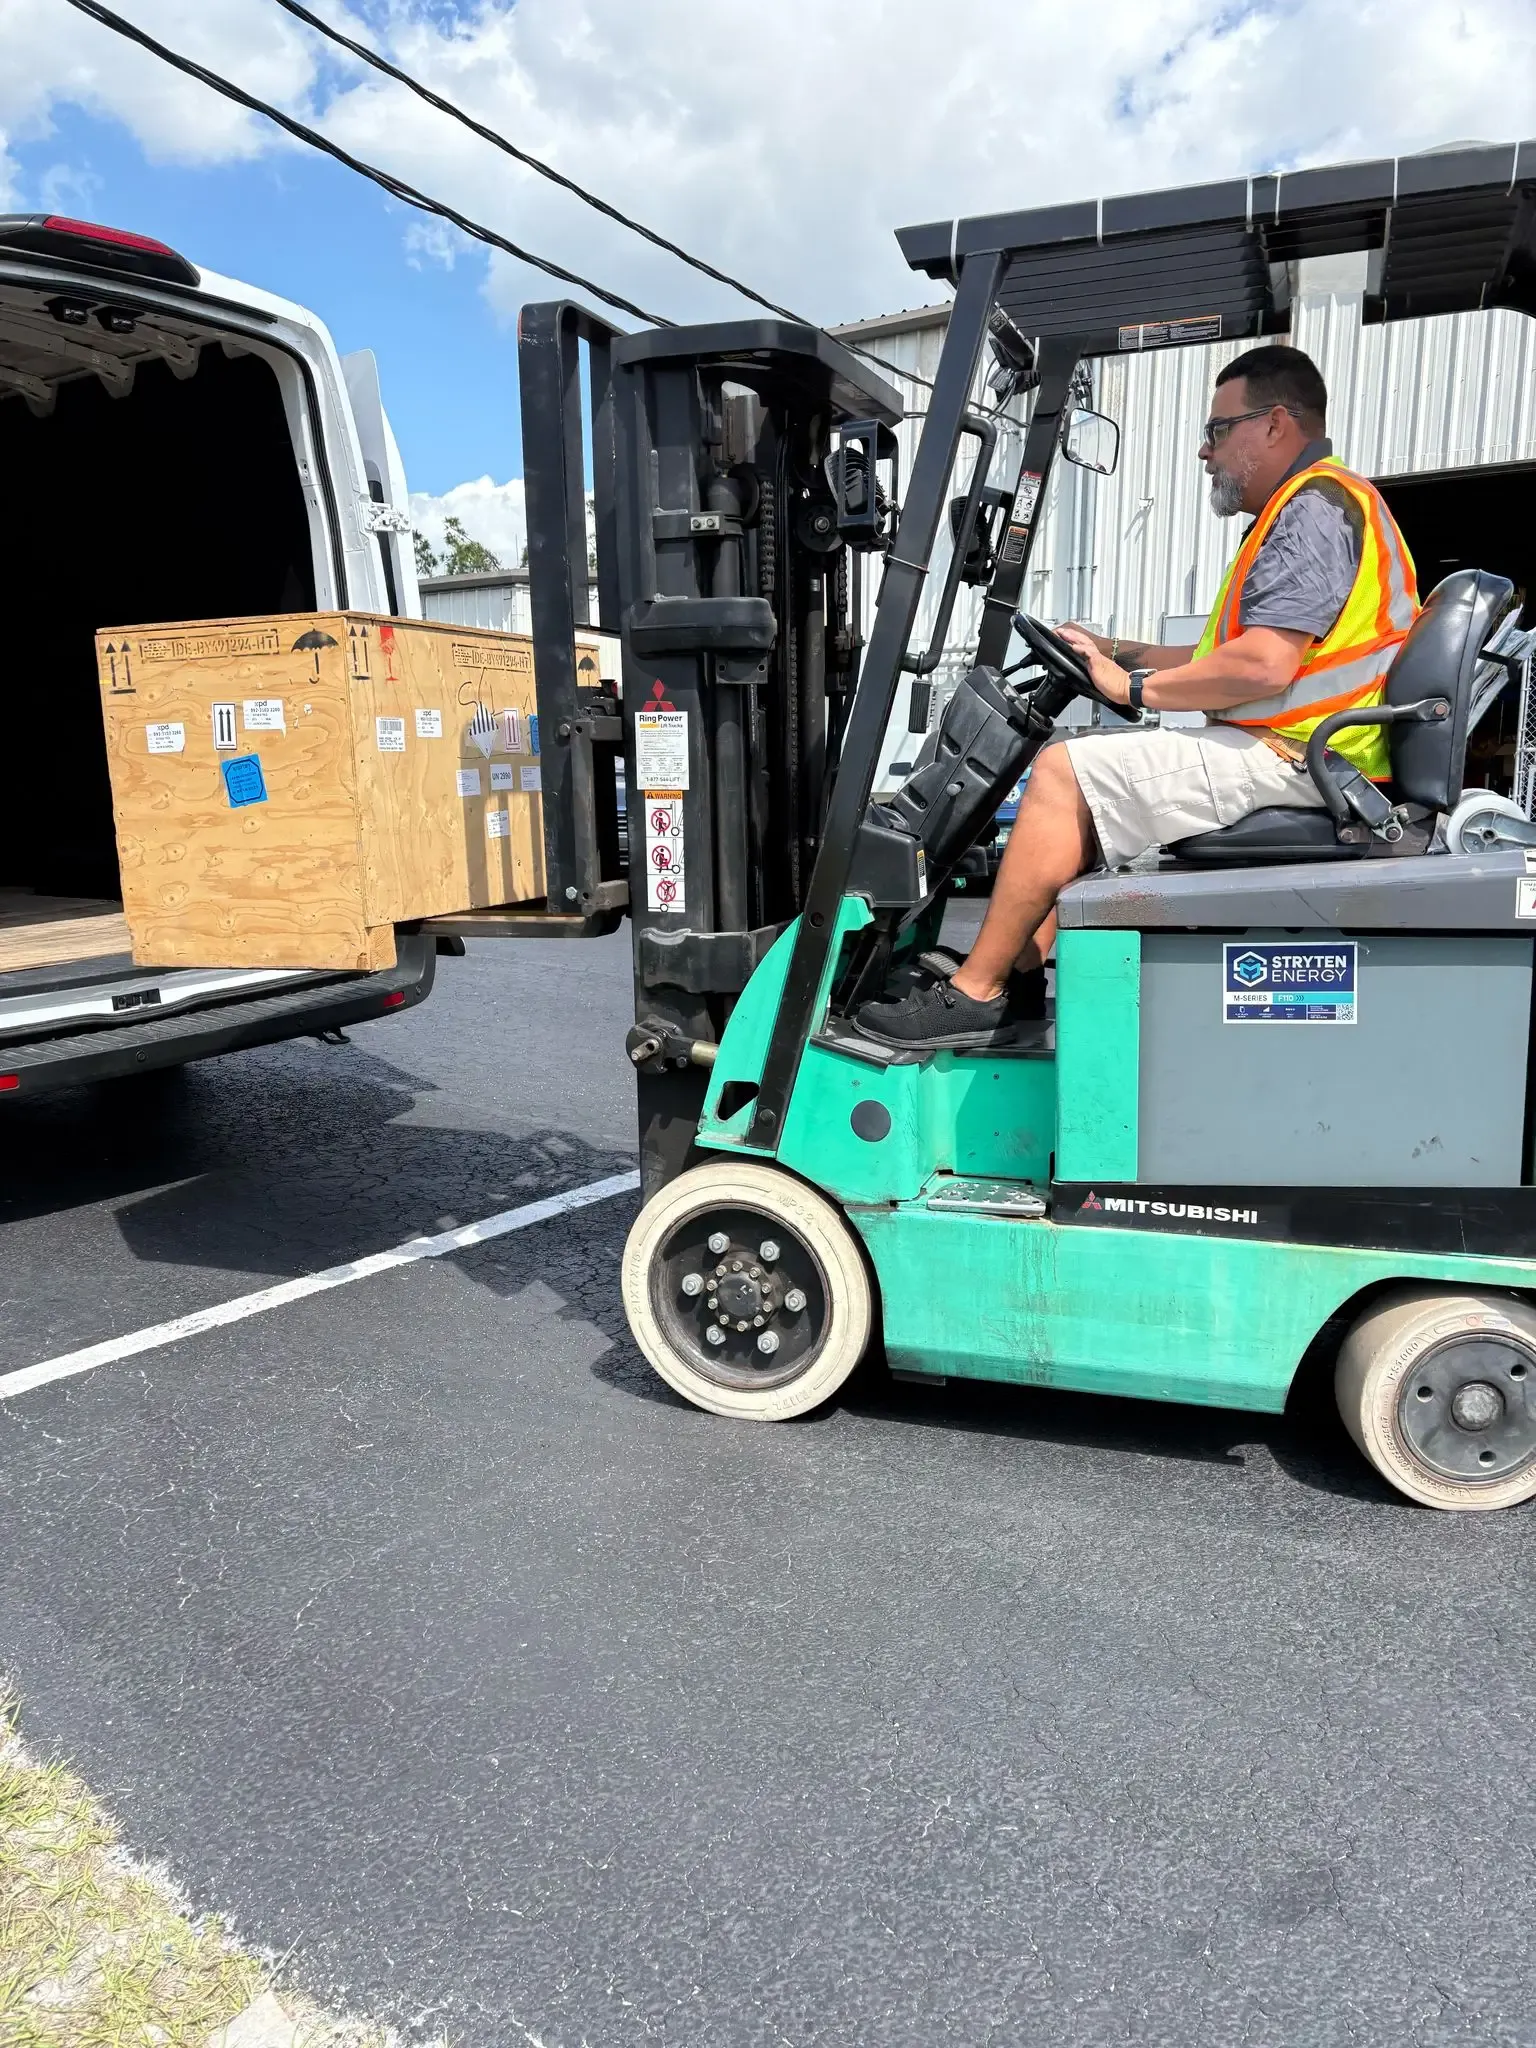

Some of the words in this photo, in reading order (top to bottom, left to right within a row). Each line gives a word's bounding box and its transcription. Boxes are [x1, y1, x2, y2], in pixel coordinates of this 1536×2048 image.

[639, 714, 657, 723] Ring
[657, 714, 683, 722] Power
[500, 772, 512, 780] 2990
[1271, 955, 1347, 969] STRYTEN
[1272, 969, 1347, 982] ENERGY
[1233, 994, 1268, 1002] M-SERIES
[1104, 1197, 1258, 1225] MITSUBISHI
